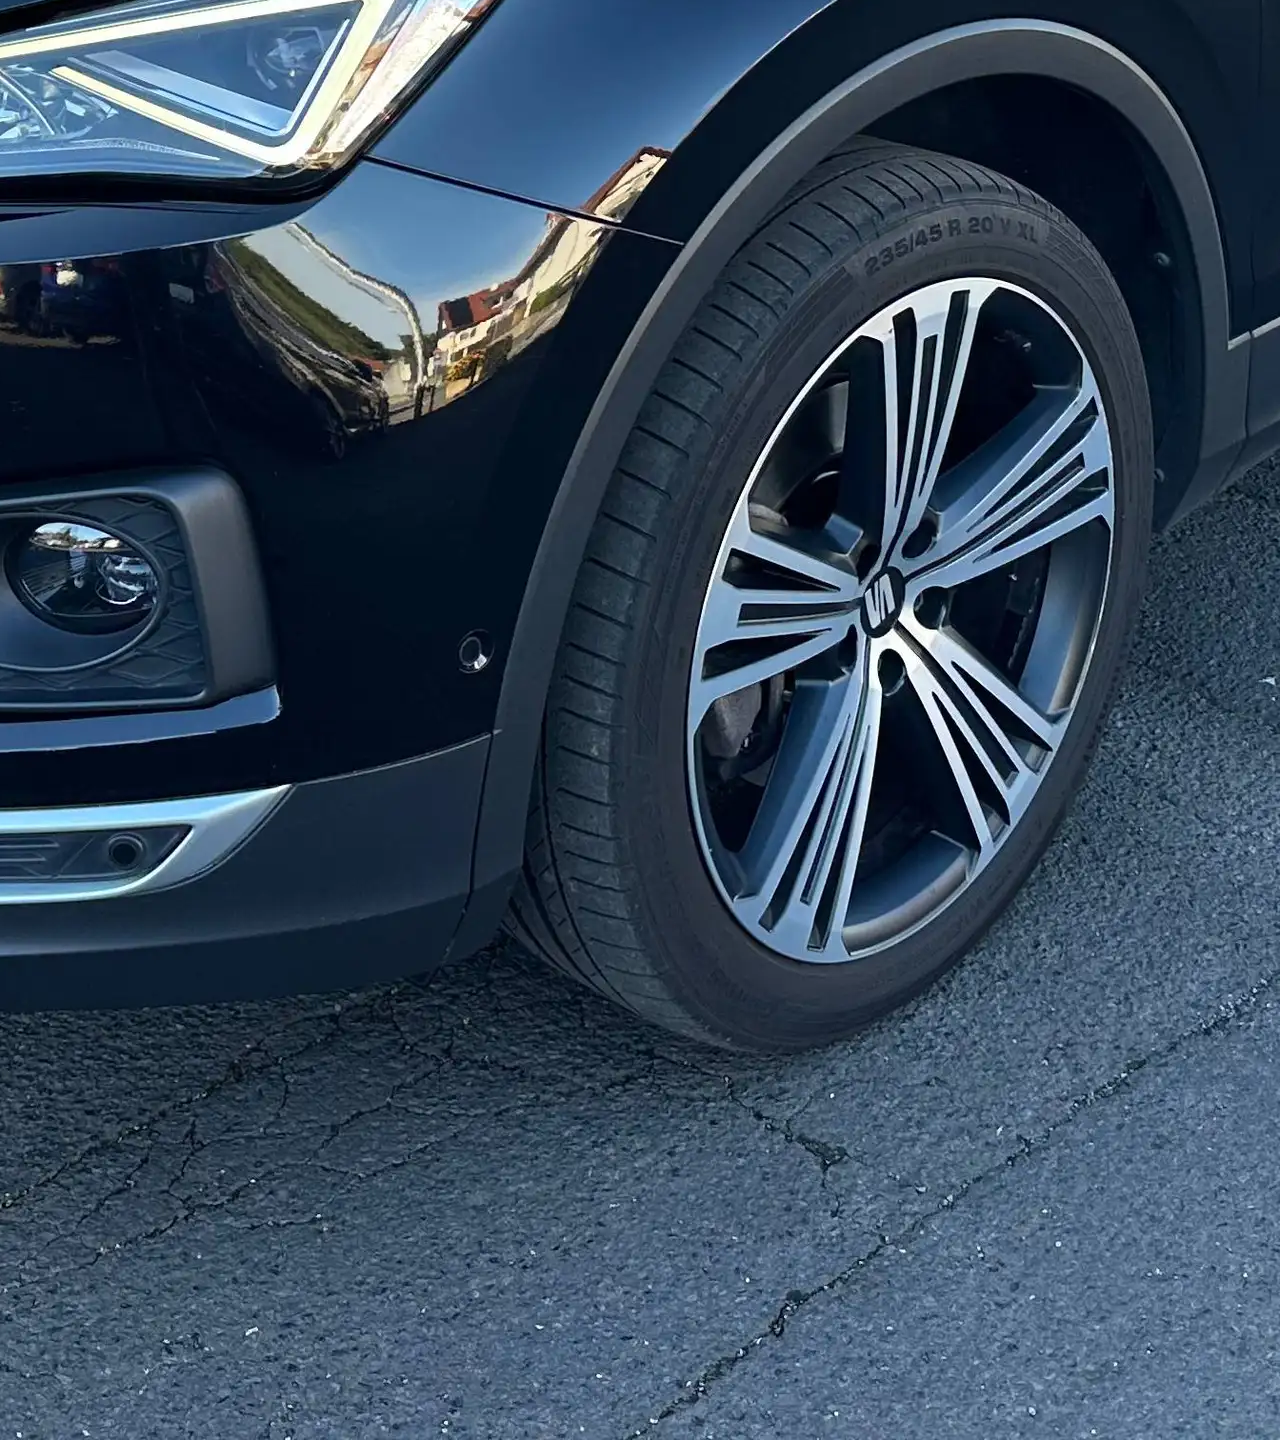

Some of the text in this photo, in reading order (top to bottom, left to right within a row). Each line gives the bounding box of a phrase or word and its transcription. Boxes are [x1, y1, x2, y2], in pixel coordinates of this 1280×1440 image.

[865, 223, 943, 276] 235/45
[948, 218, 962, 238] R
[967, 216, 994, 234] 20
